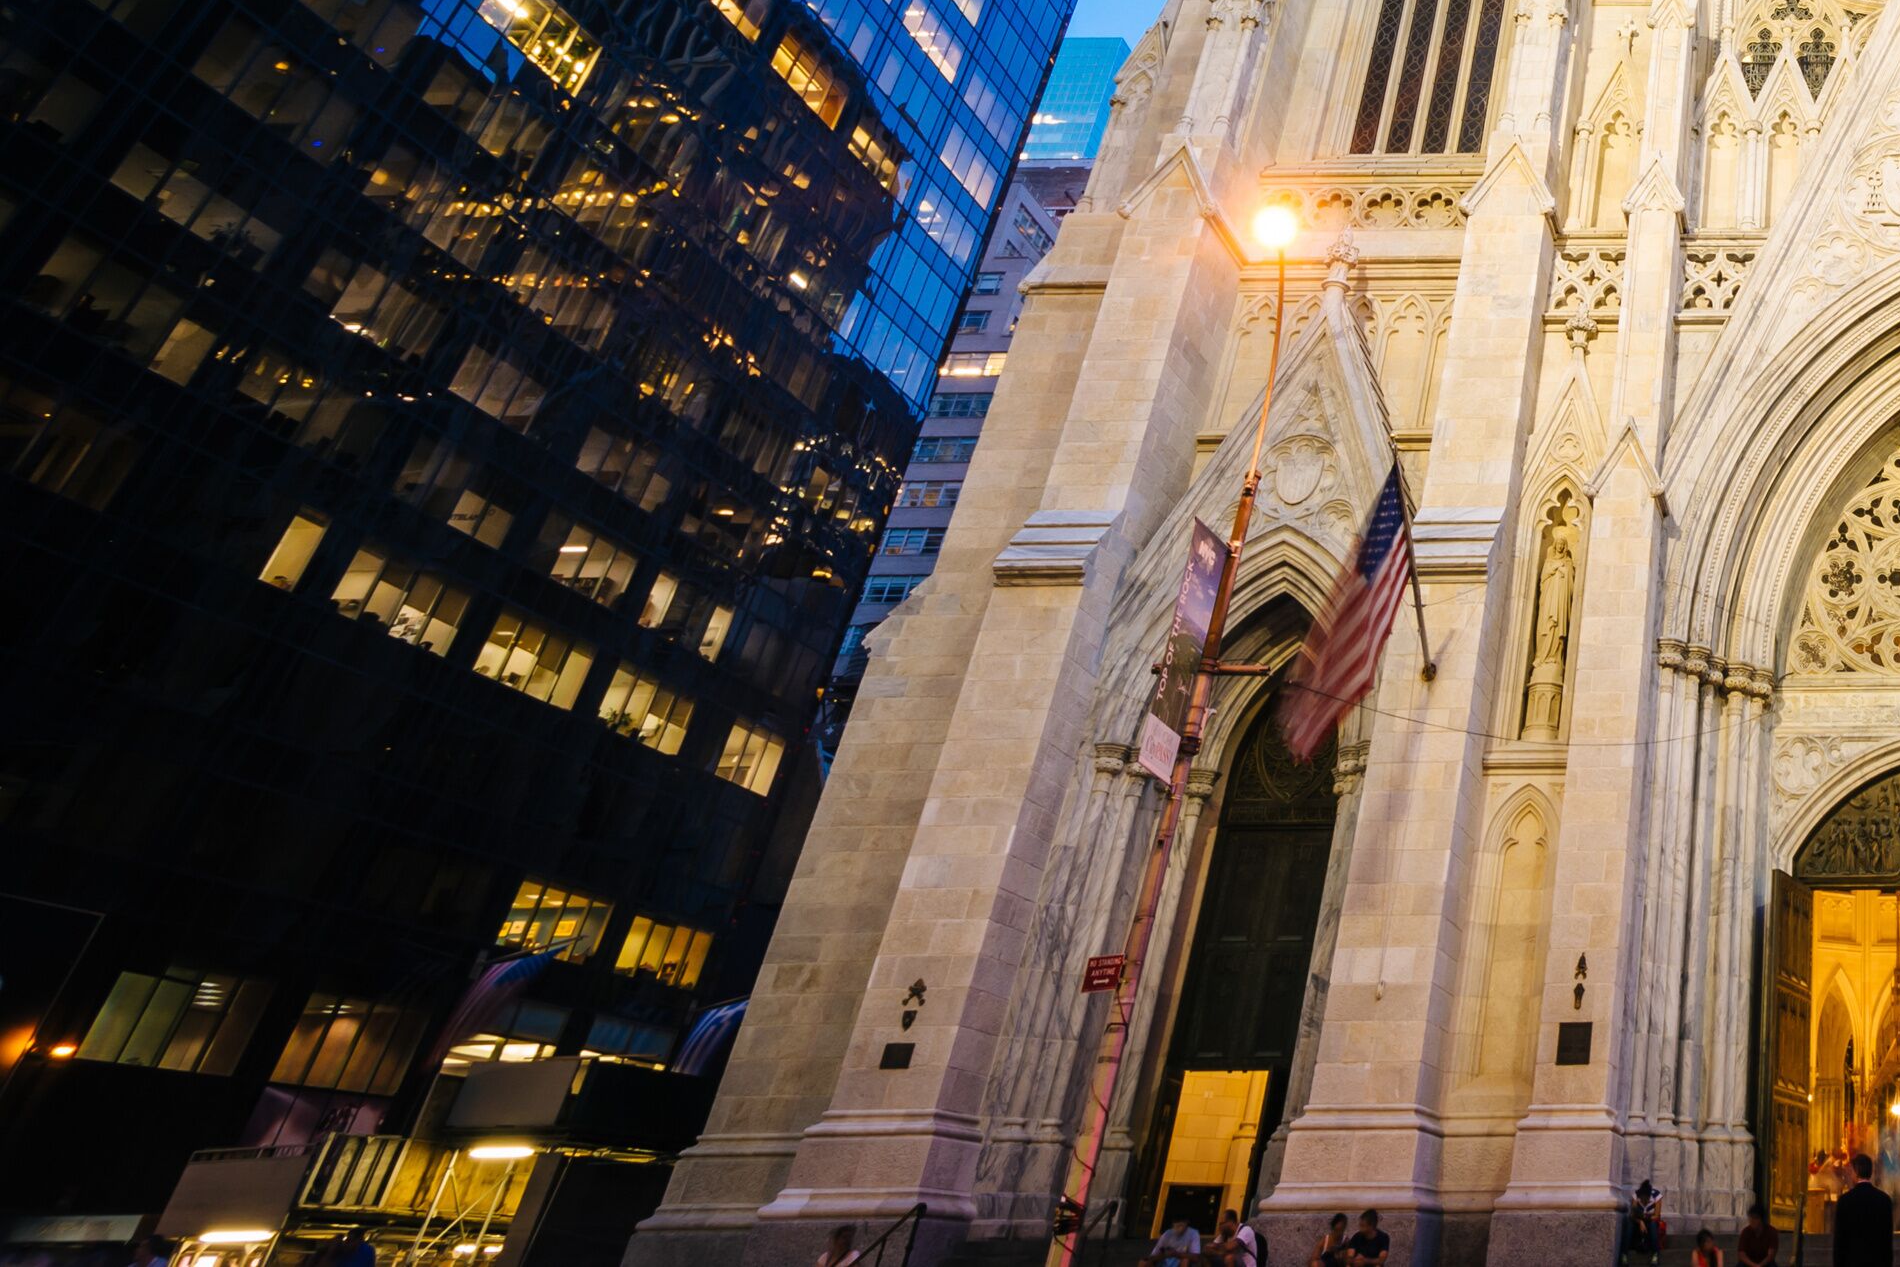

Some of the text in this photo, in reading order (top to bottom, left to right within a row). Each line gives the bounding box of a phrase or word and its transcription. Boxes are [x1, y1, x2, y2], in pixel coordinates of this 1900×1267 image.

[1156, 561, 1195, 701] TOP OF THE ROCK
[1098, 957, 1121, 966] STANDING
[1091, 967, 1116, 976] ANYTIME
